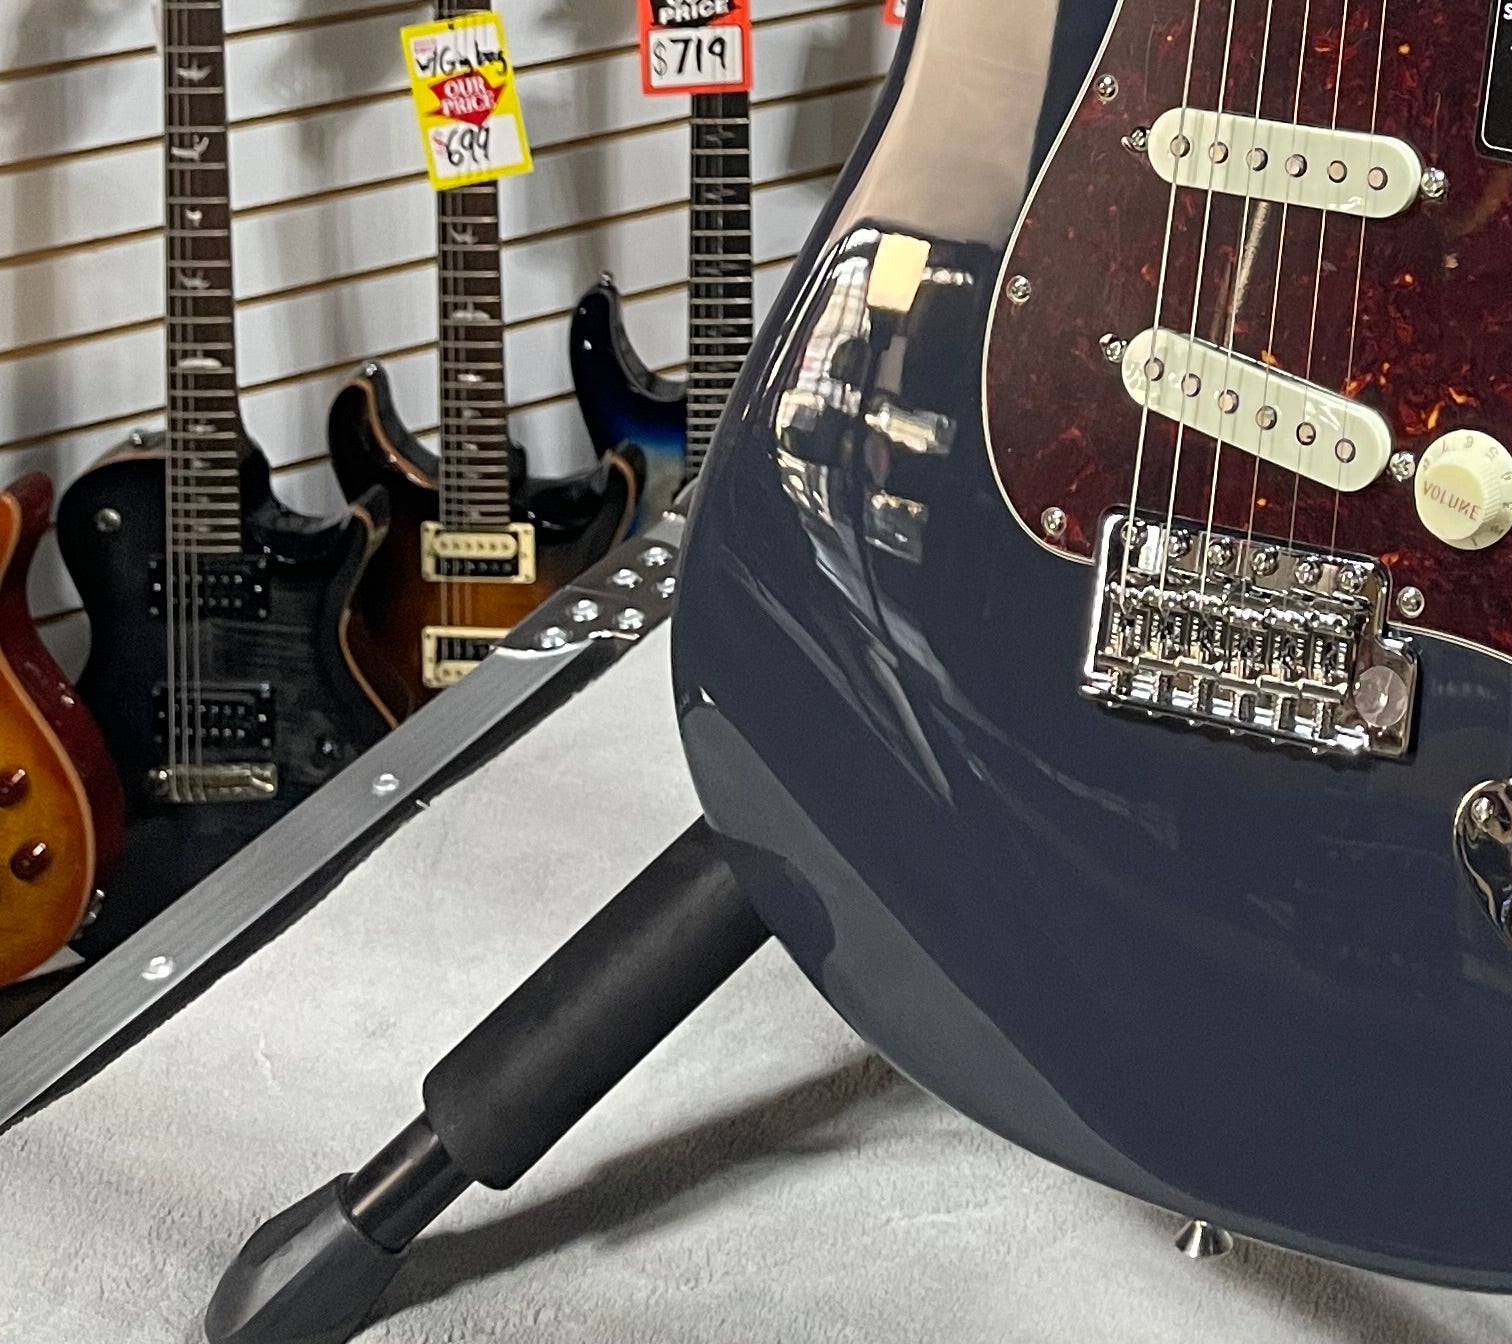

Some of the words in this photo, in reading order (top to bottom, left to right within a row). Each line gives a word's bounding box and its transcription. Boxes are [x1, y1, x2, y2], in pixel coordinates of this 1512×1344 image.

[653, 36, 727, 79] $719
[440, 89, 497, 116] PRICE
[443, 75, 486, 99] OUR
[1423, 479, 1481, 522] VOLUME
